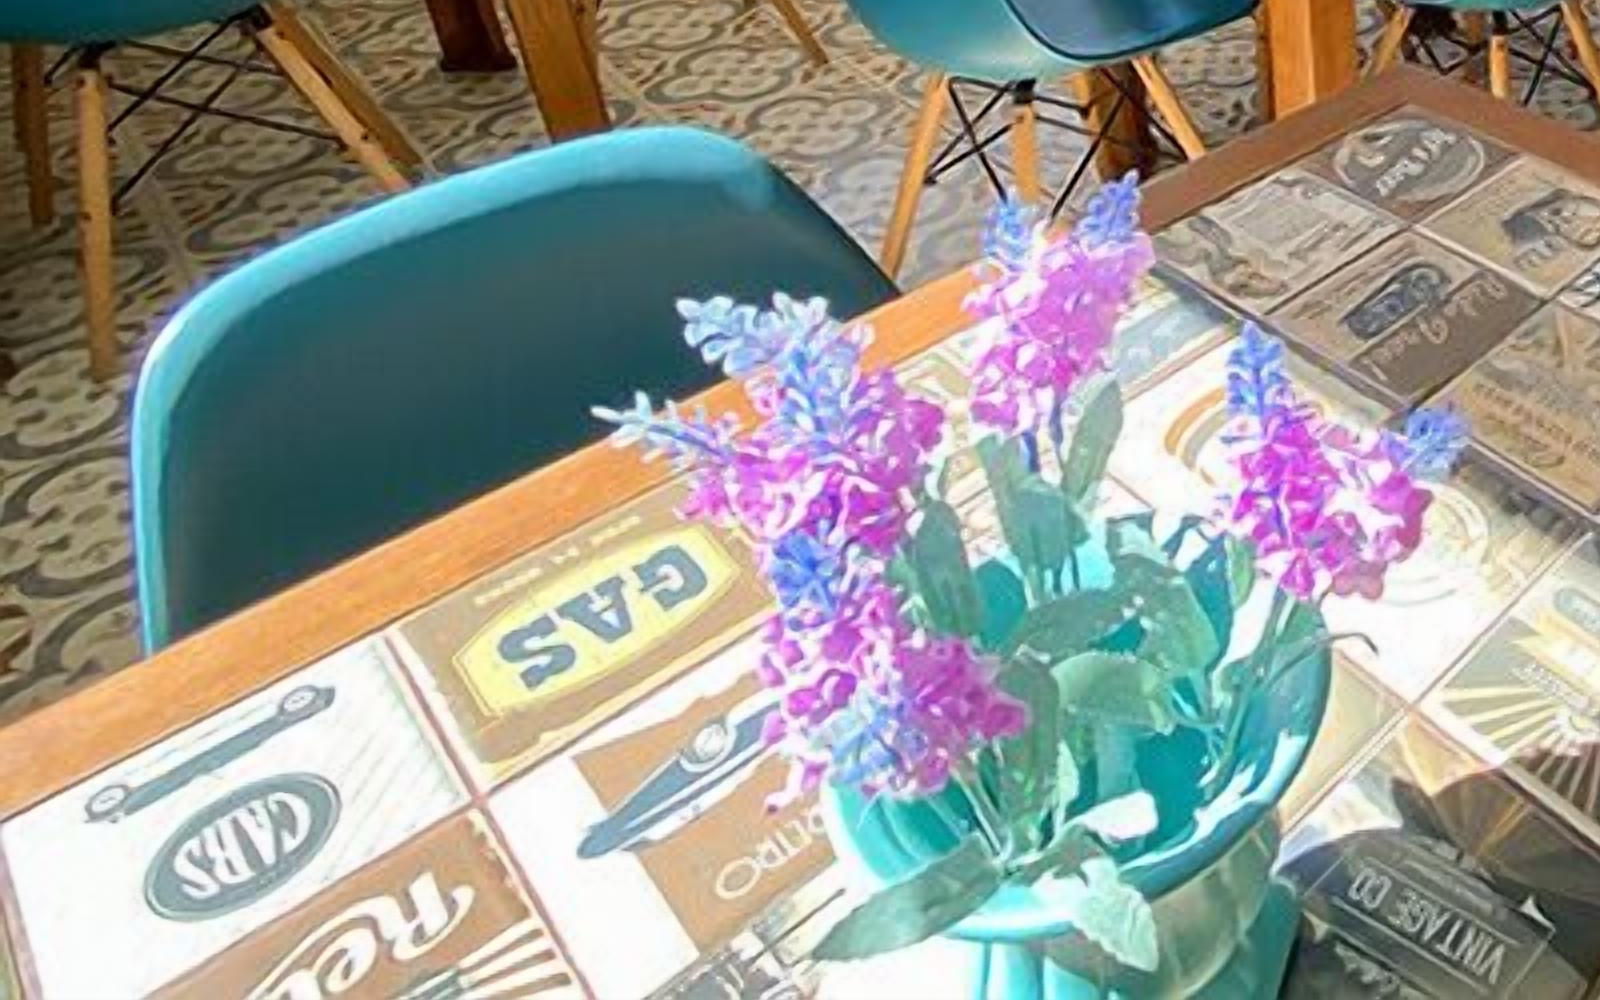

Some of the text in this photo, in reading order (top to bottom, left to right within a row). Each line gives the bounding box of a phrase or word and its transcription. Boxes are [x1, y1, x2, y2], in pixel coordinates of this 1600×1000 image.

[496, 543, 709, 691] GAS
[172, 789, 312, 899] CARS
[1387, 888, 1506, 986] VINTAGE
